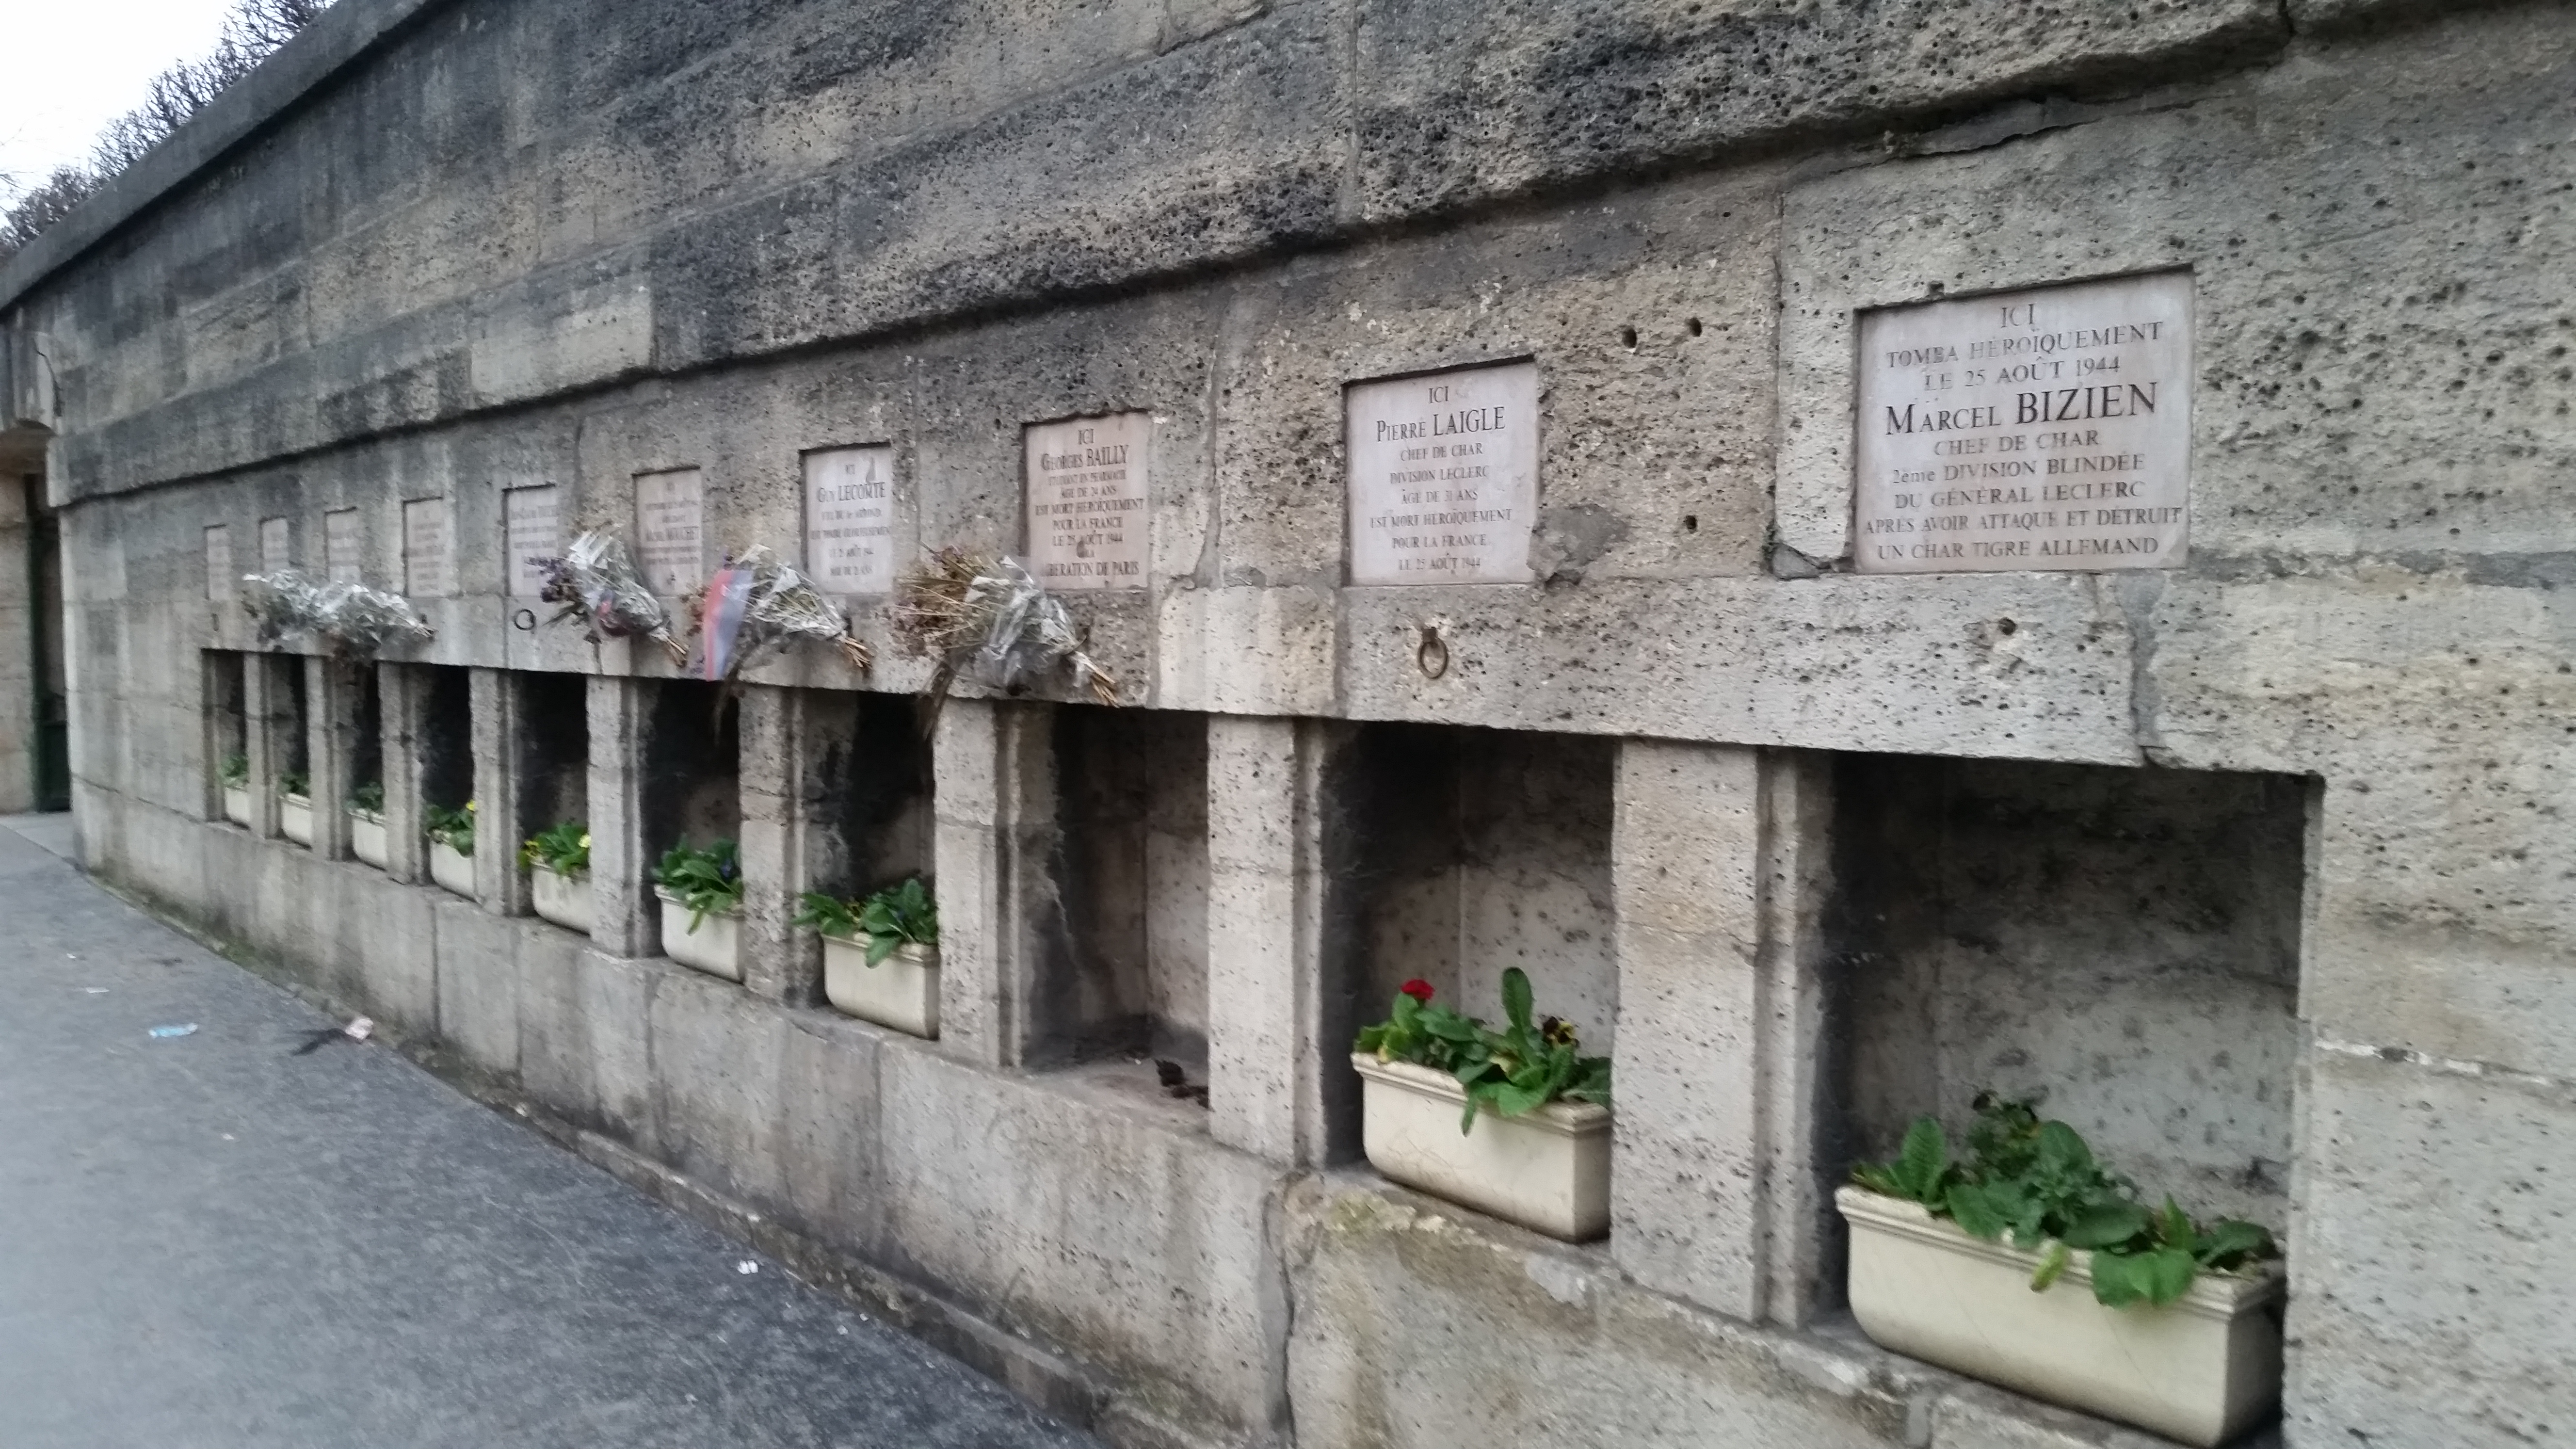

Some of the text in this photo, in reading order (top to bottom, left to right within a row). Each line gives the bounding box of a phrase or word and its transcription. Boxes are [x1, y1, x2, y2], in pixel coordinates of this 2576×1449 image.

[2001, 304, 2035, 328] ICI
[1887, 346, 1958, 368] TOMBA
[1925, 356, 2120, 390] LE 25 AOÛT 1944
[1429, 386, 1449, 403] ICI
[1886, 382, 2157, 435] MARCEL BIZIEN
[1433, 406, 1505, 436] LAIGLE
[1079, 429, 1094, 445] ICI
[1934, 430, 2099, 455] CHEF DE CHAR
[1087, 445, 1129, 467] BAILLY
[1401, 443, 1482, 461] CHEF DE CHAR
[1390, 466, 1489, 483] DIVISION LECLERC
[1944, 460, 2036, 481] DIVISION
[2047, 451, 2145, 474] BLINDÉE
[1426, 491, 1440, 503] DE
[1456, 488, 1478, 501] ANS
[1895, 481, 2145, 509] DU GÉNÉRAL LECLERC
[1370, 517, 1386, 528] EST
[1391, 515, 1419, 527] MORT
[1922, 515, 1969, 531] AVOIR
[2067, 510, 2089, 527] ET
[1392, 534, 1487, 548] POUR LA FRANCE
[1878, 538, 2158, 560] UN CHAR TIGRE ALLEMAND
[1400, 559, 1411, 570] LE
